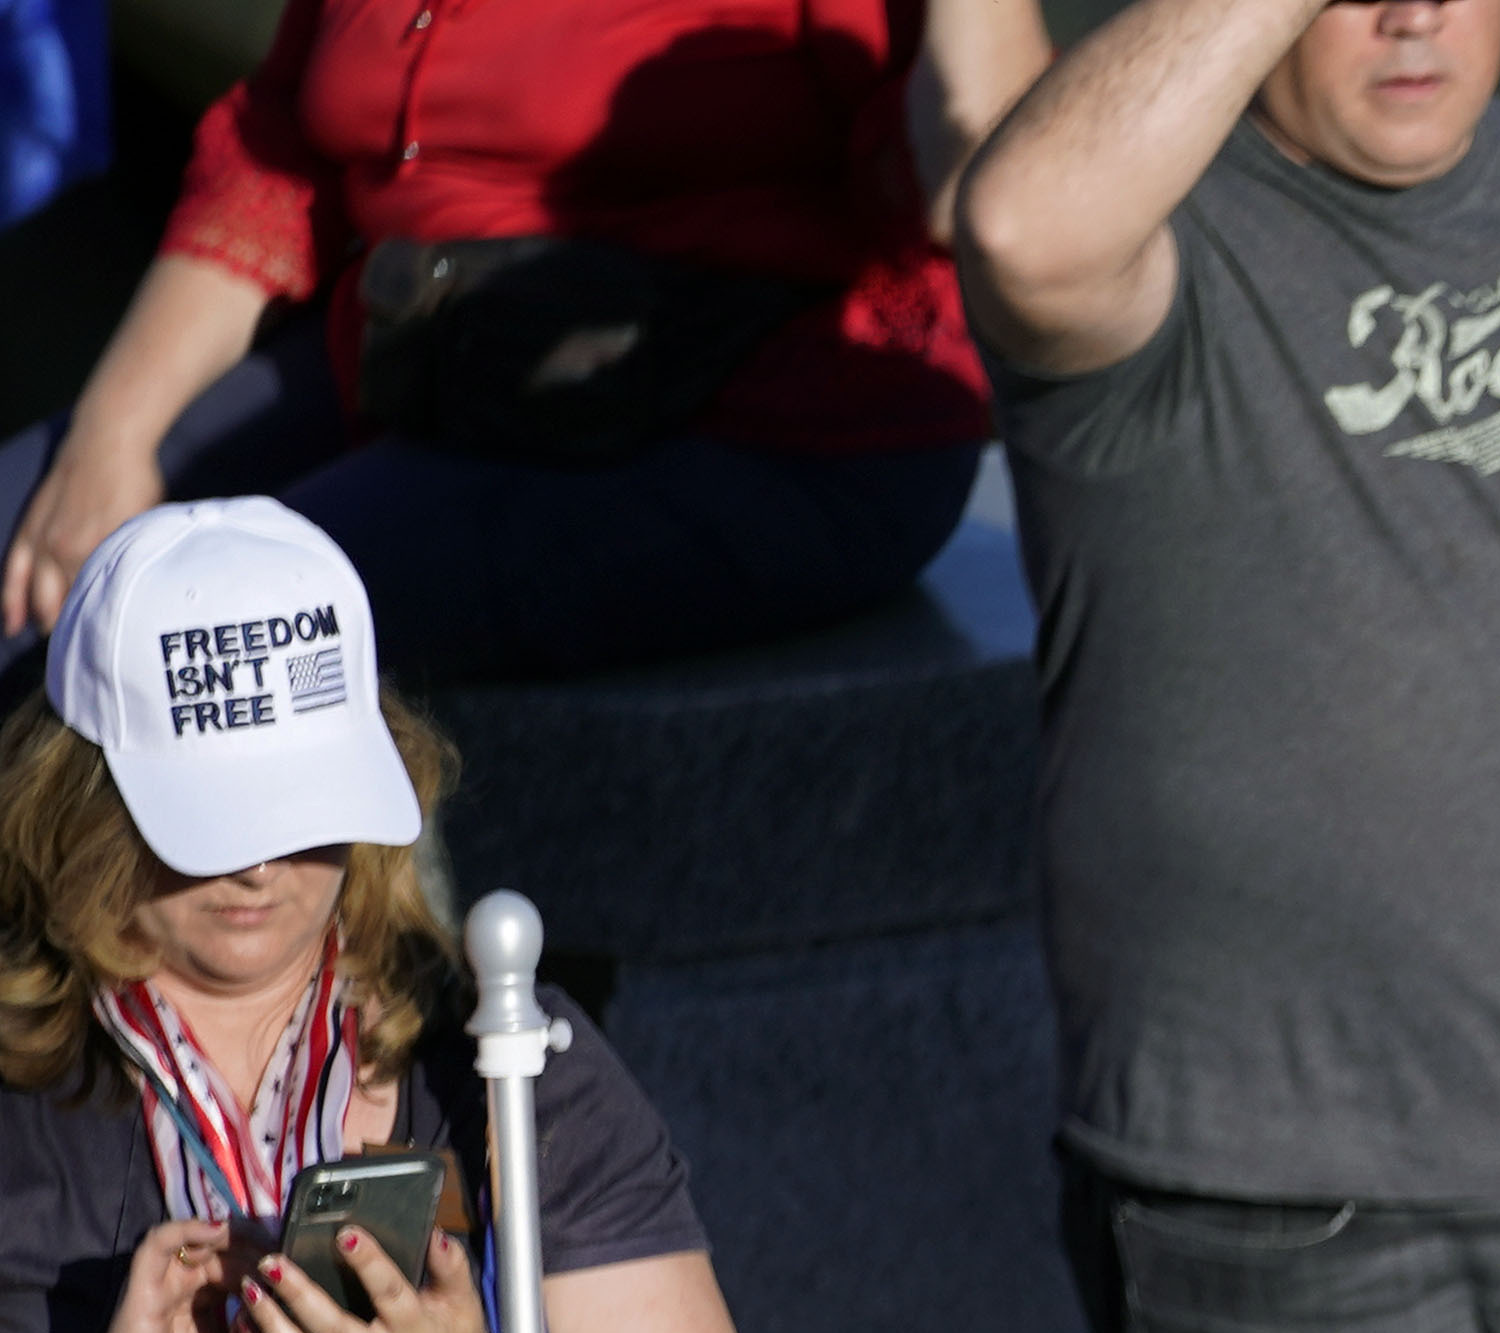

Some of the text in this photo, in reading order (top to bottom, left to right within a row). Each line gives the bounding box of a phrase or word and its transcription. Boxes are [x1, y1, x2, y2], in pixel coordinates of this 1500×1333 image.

[160, 604, 340, 662] FREEDOM
[166, 656, 269, 700] ISN'T
[171, 694, 276, 737] FREE
